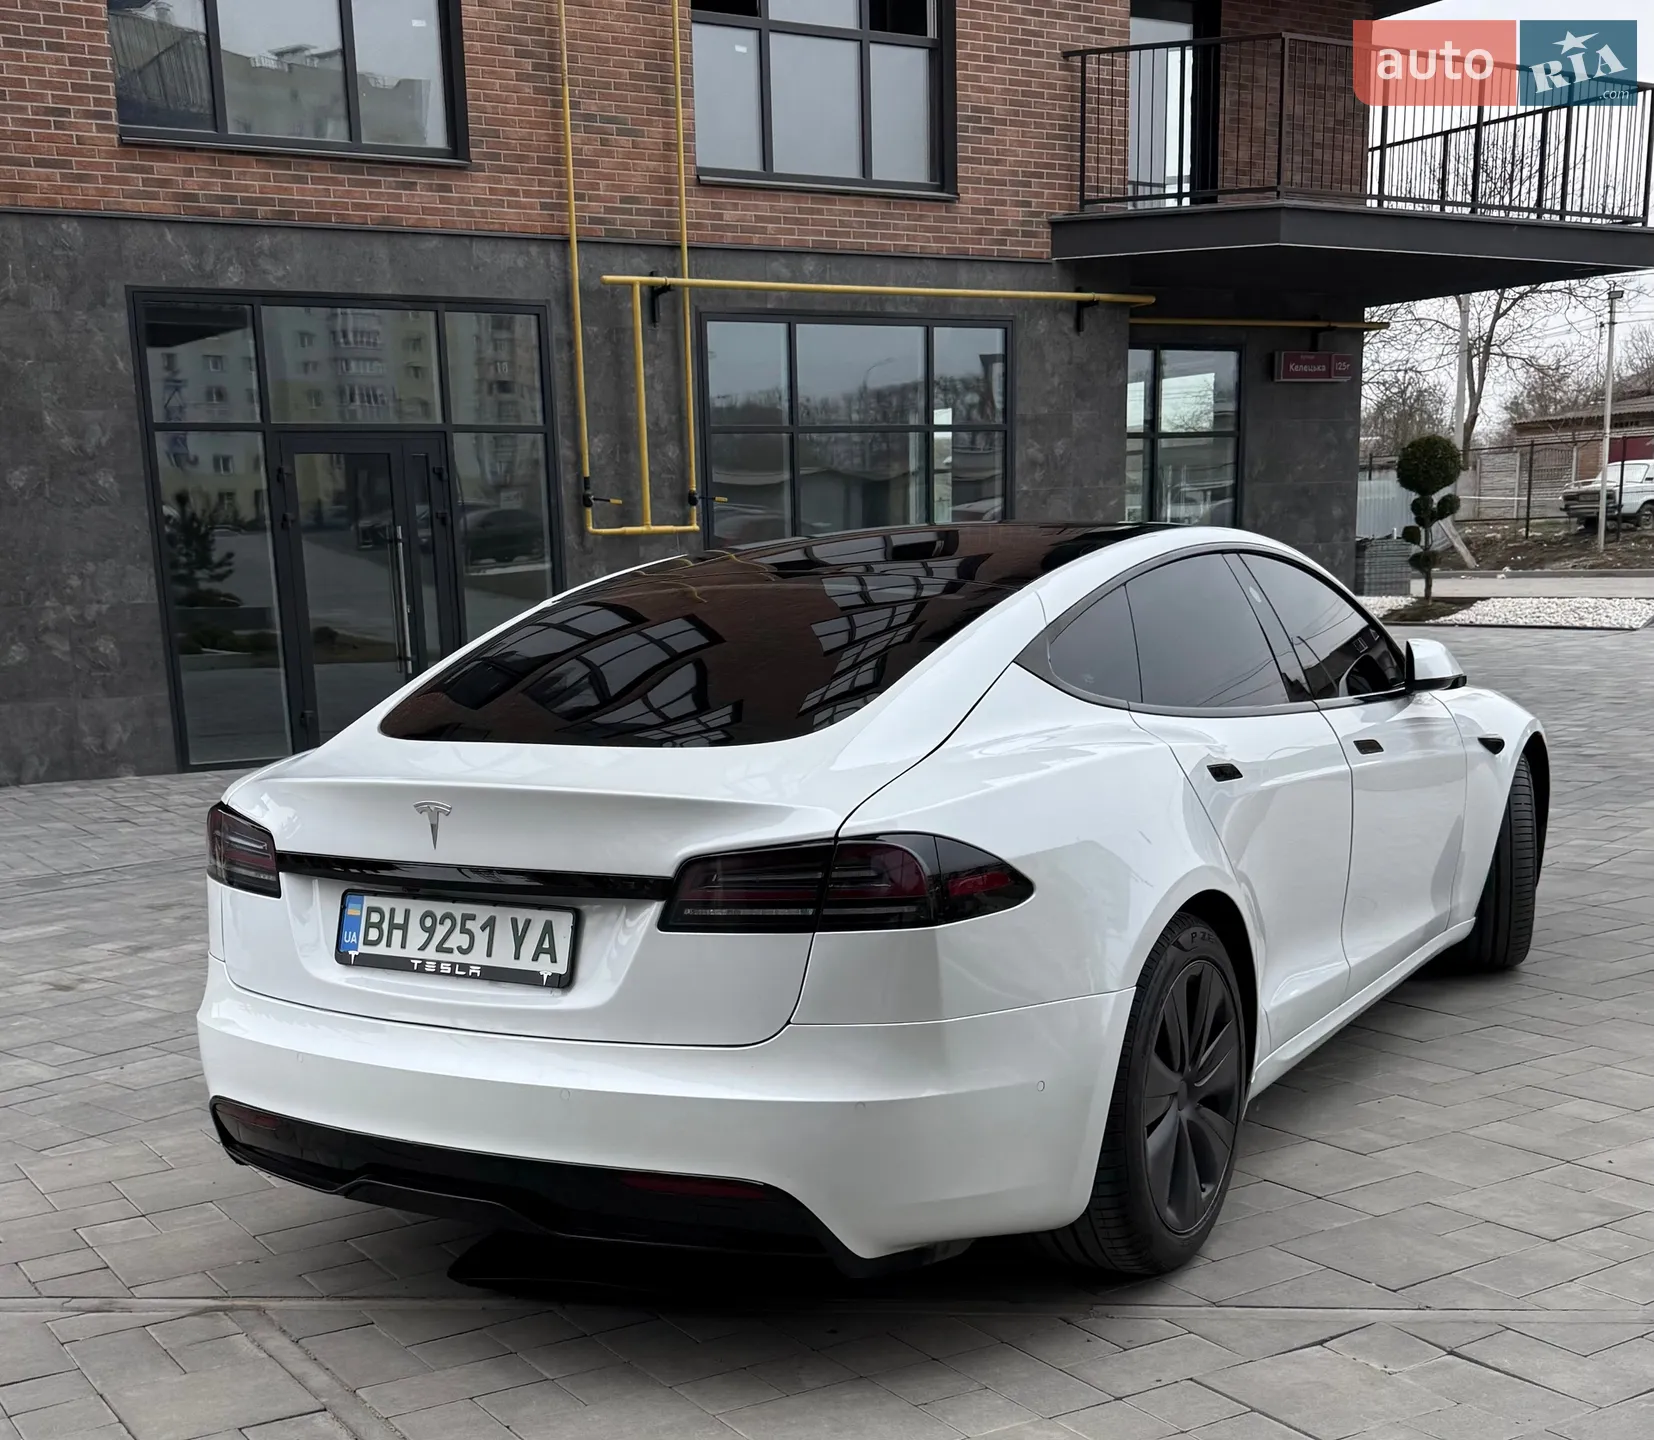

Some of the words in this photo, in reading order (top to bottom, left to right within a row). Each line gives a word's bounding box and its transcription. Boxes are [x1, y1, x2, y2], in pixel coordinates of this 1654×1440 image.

[1289, 362, 1326, 372] Келецька
[344, 930, 357, 944] UA
[362, 905, 411, 950] BH
[417, 909, 497, 959] 9251
[510, 916, 558, 964] YA
[410, 959, 482, 978] TESLA
